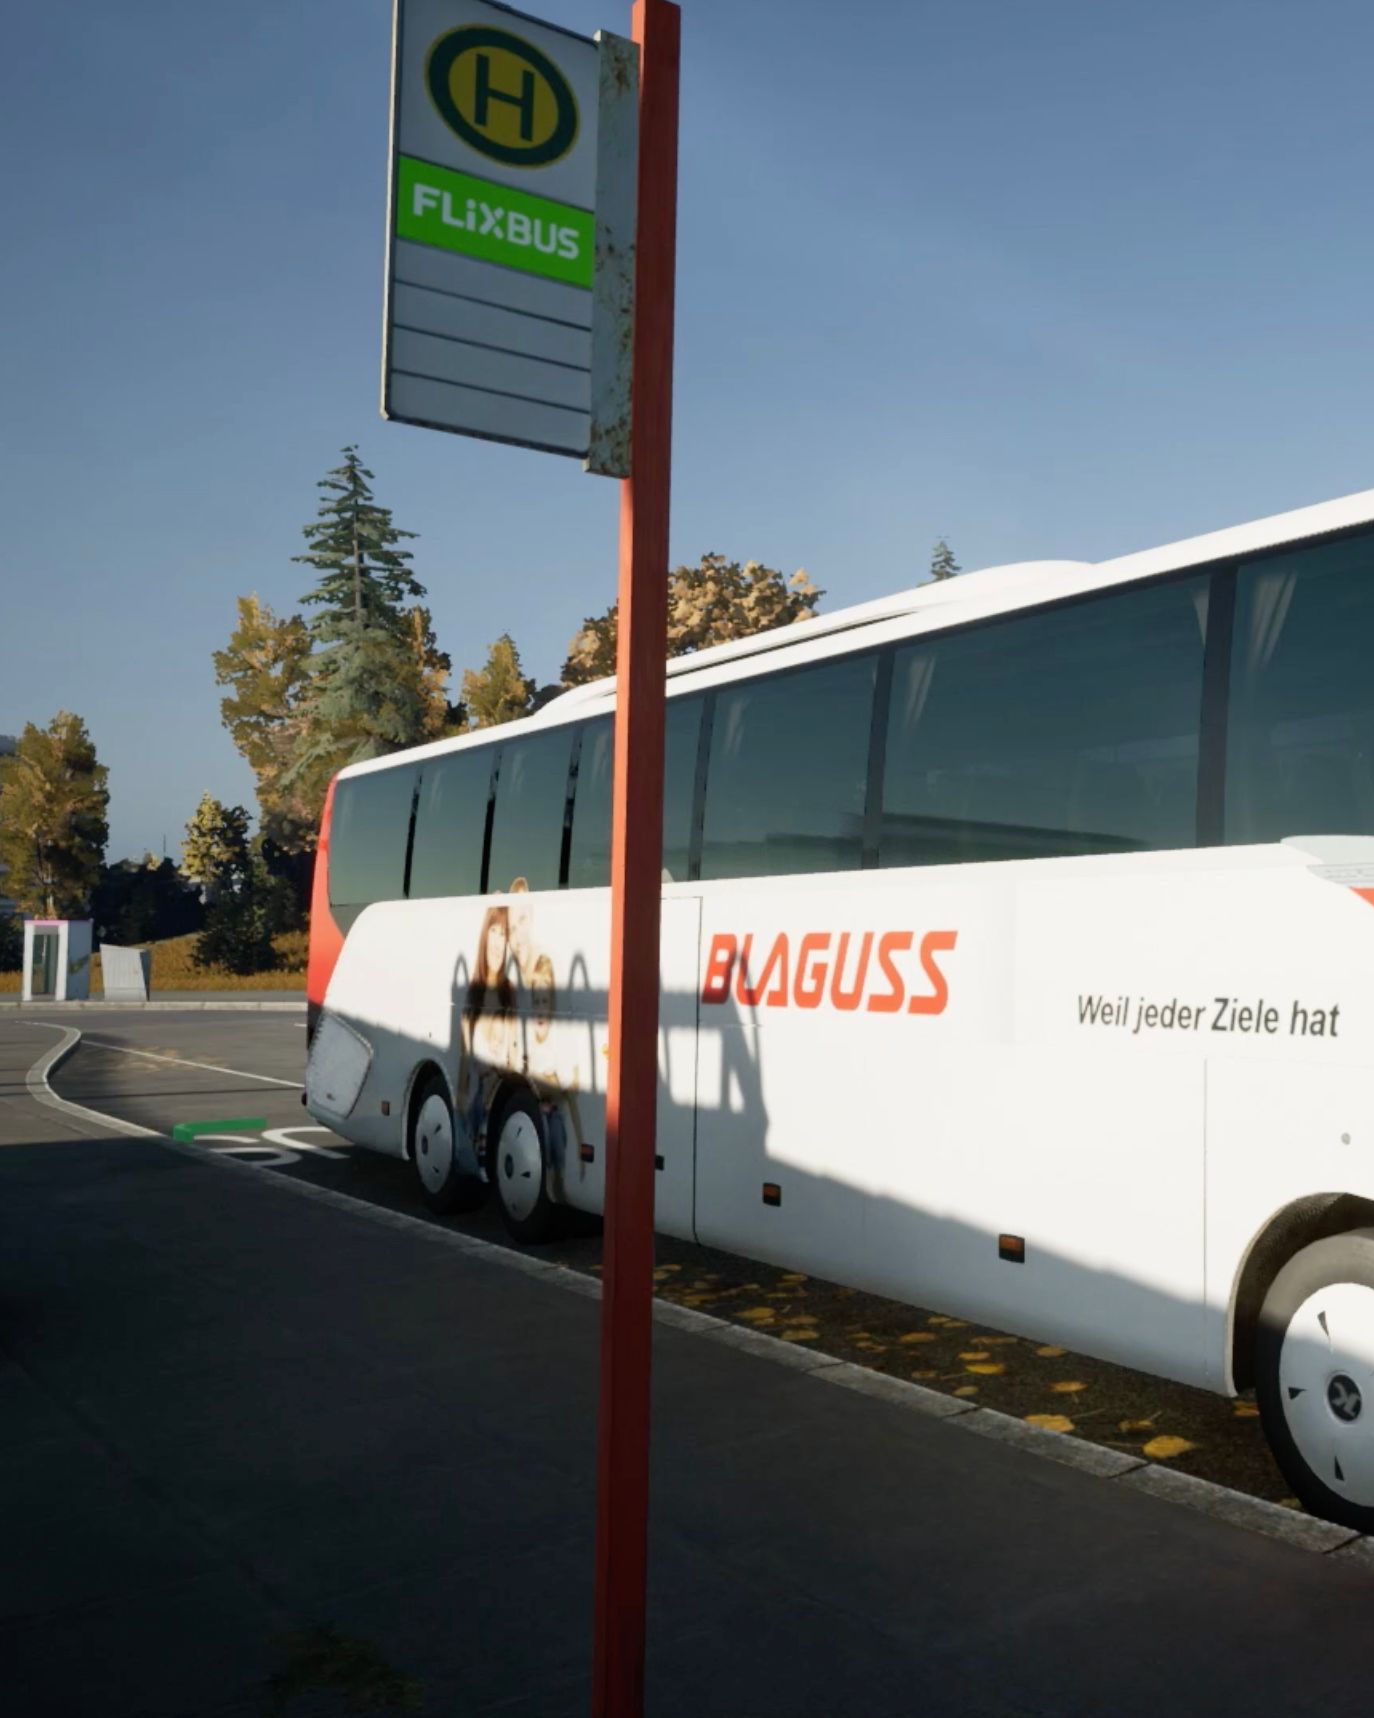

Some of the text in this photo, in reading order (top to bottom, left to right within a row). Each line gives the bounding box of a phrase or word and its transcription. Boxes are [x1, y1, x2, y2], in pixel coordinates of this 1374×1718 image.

[475, 54, 534, 142] H
[701, 929, 958, 1016] BLAGUSS
[1077, 995, 1340, 1037] Weil jeder Ziele hat
